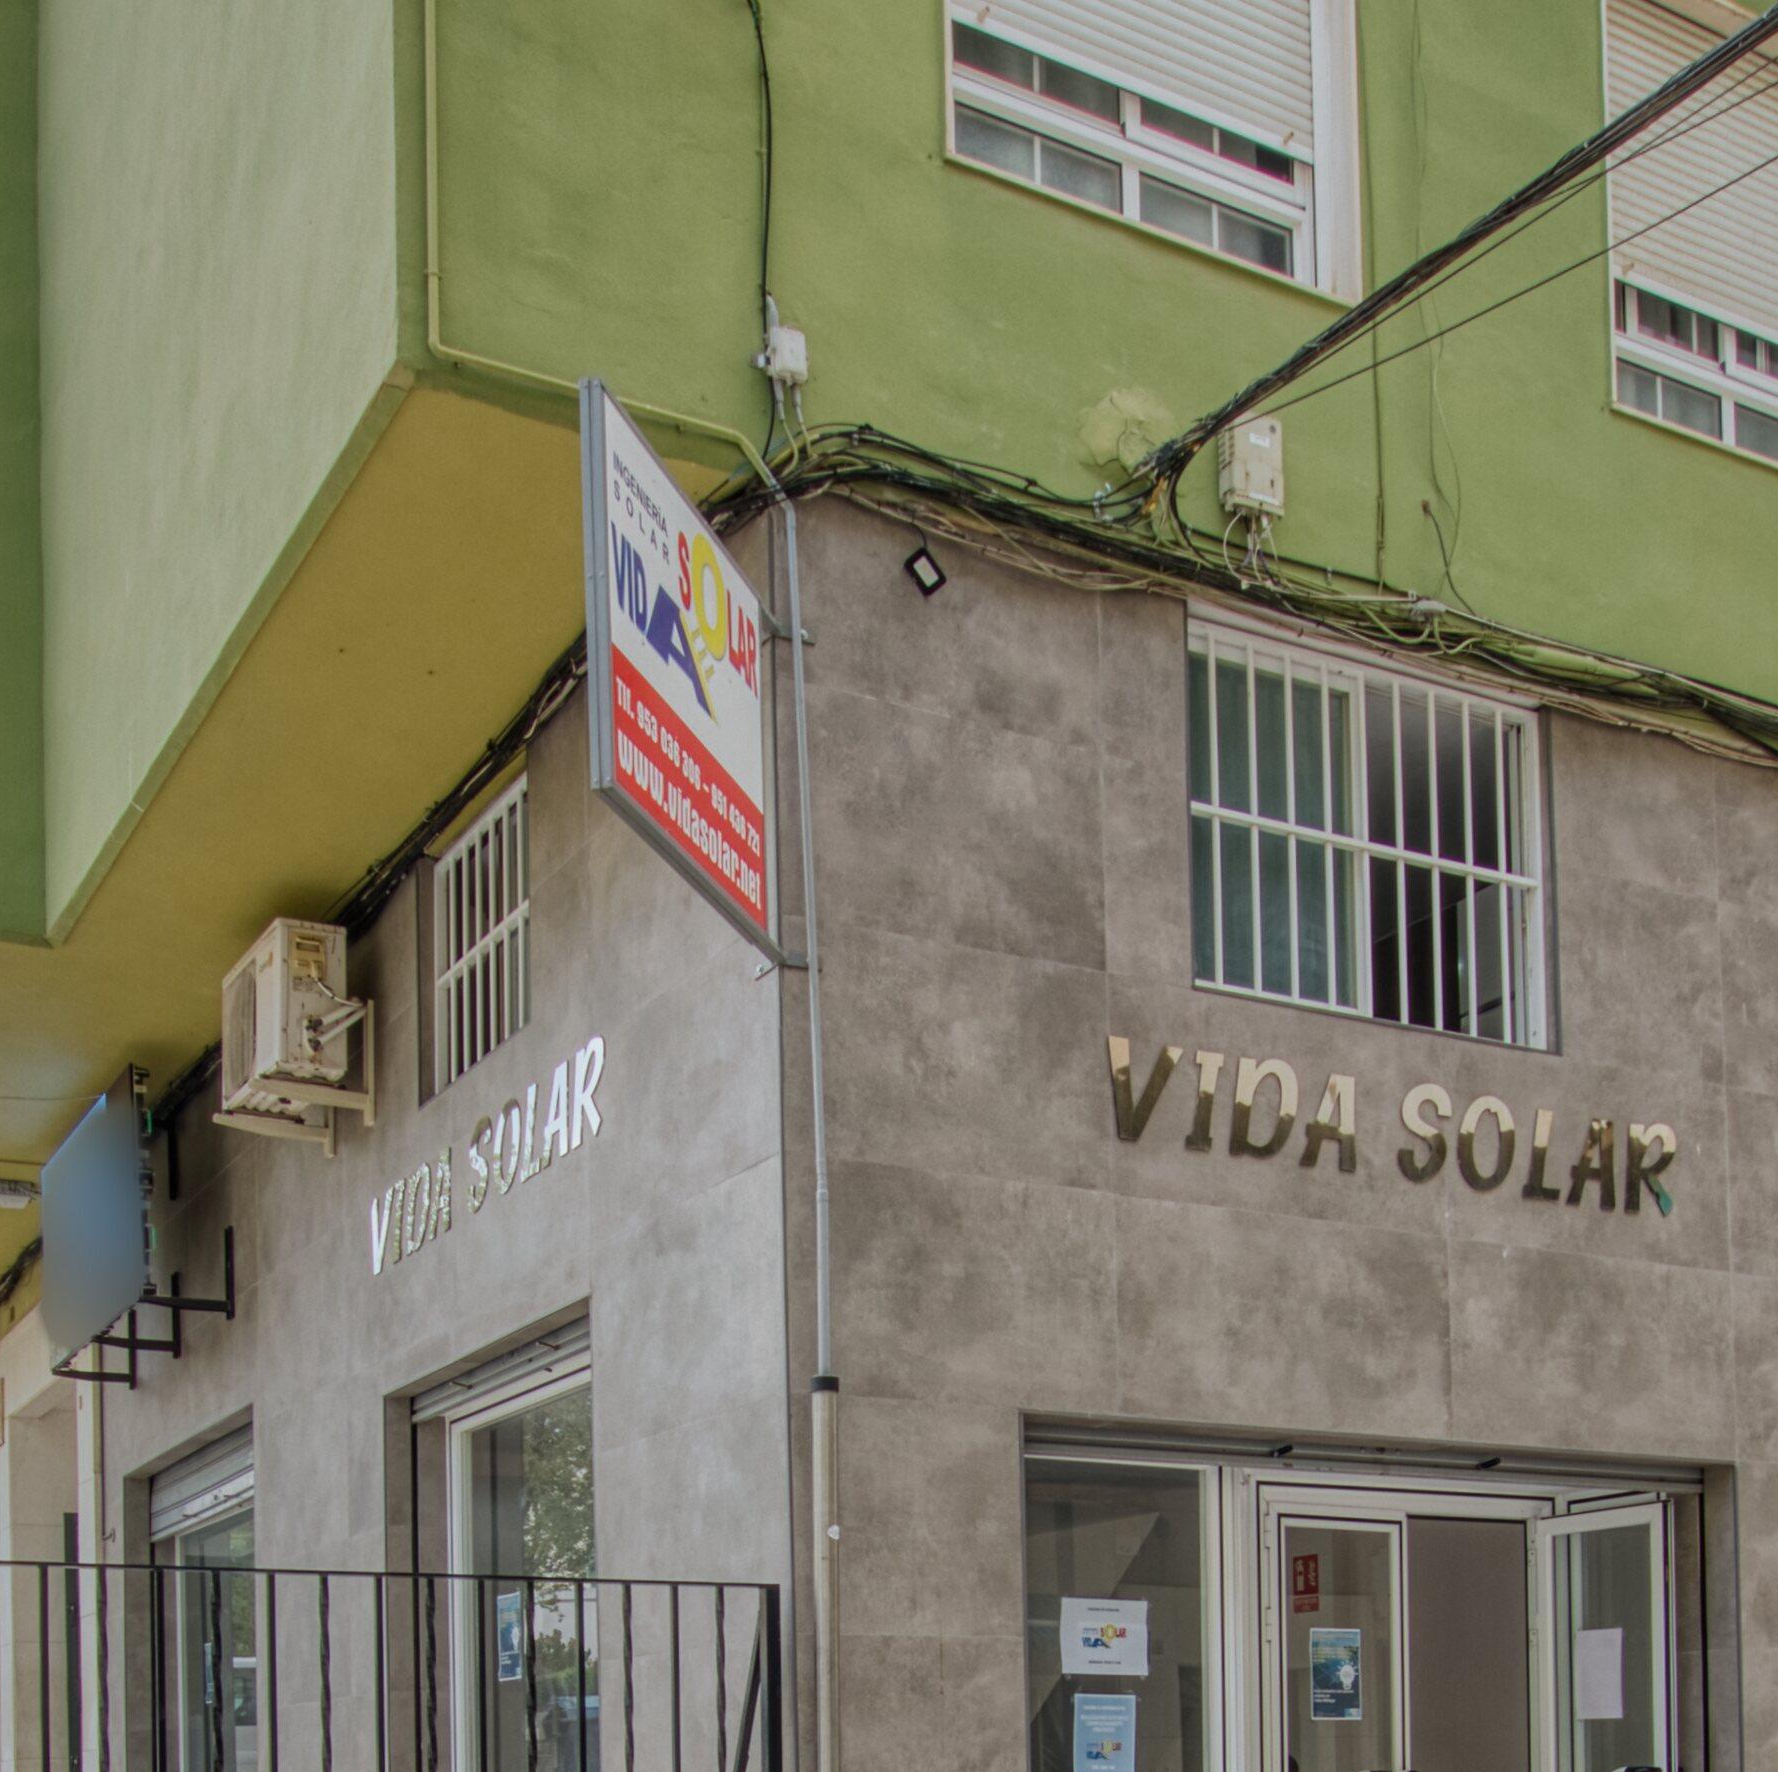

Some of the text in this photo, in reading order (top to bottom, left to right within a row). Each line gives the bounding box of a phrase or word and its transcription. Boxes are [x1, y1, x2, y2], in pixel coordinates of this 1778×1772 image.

[613, 479, 670, 566] SOLAR
[611, 521, 712, 718] VIDA
[678, 530, 759, 700] SOLAR
[616, 728, 762, 911] www.vidasolar.net
[371, 1034, 607, 1276] VIDA SOLAR
[1107, 1035, 1677, 1217] VIDA SOLAR
